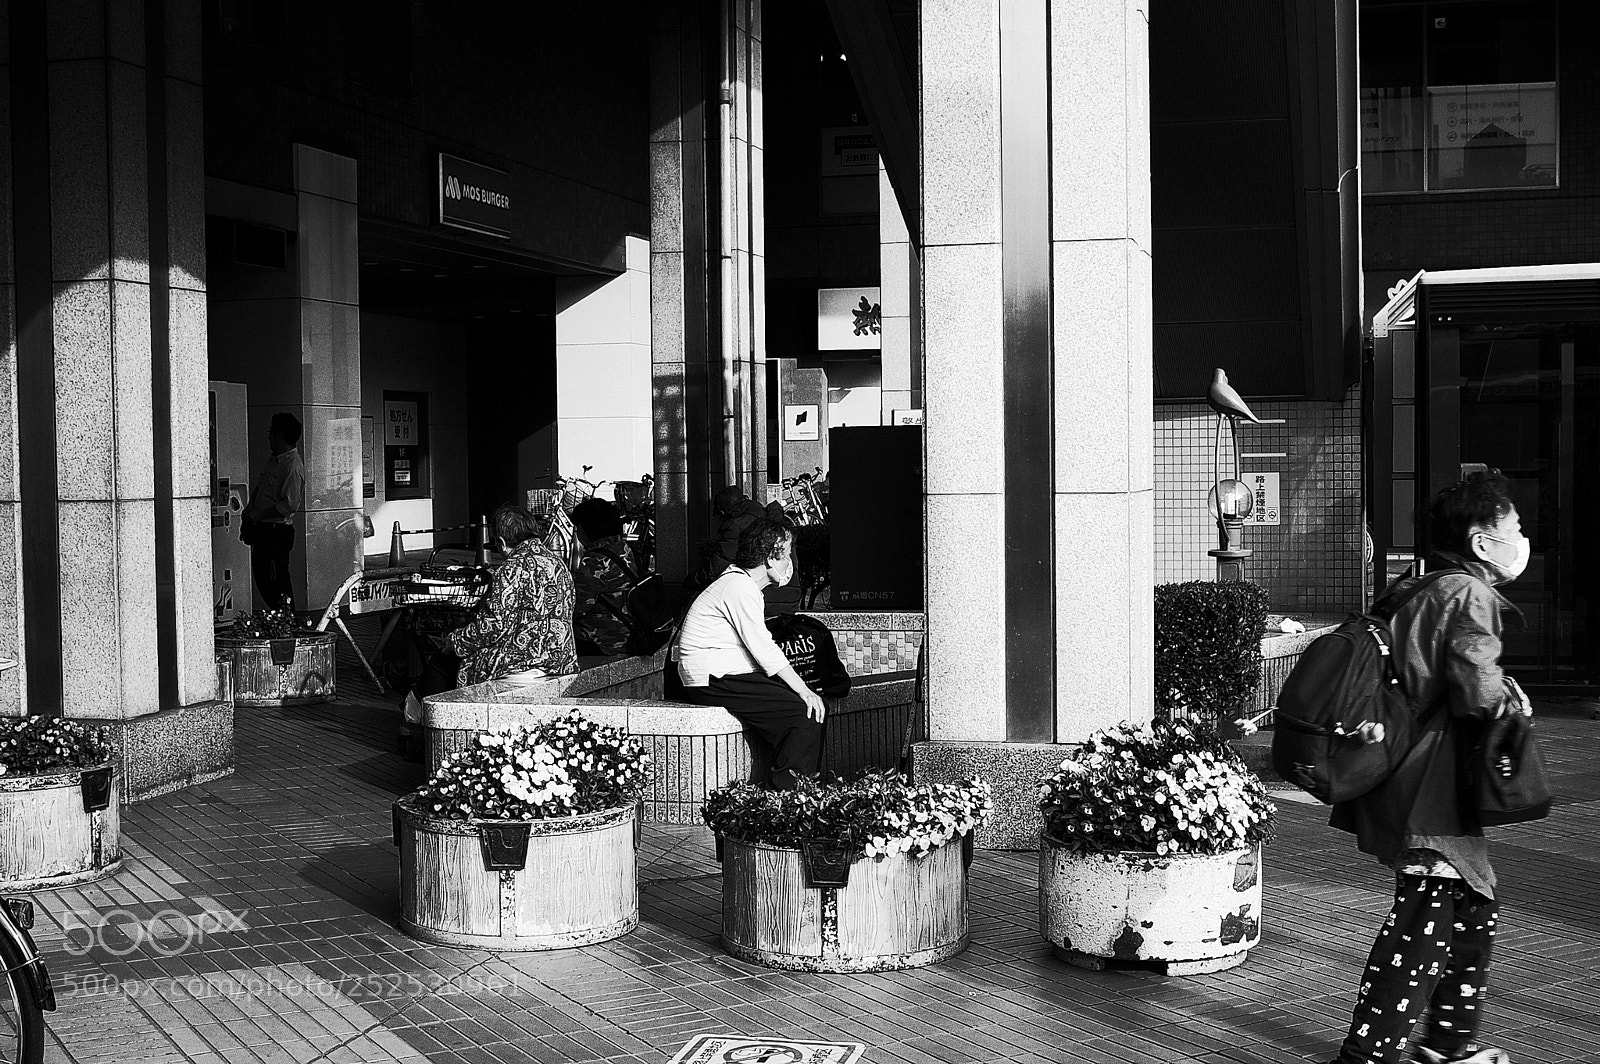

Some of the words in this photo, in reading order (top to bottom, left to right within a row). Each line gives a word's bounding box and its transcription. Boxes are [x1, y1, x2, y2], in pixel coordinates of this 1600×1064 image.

[462, 183, 481, 202] MOS
[481, 188, 510, 210] BURGER
[389, 409, 413, 423] 処方せん
[1255, 475, 1266, 523] 路上禁煙地区
